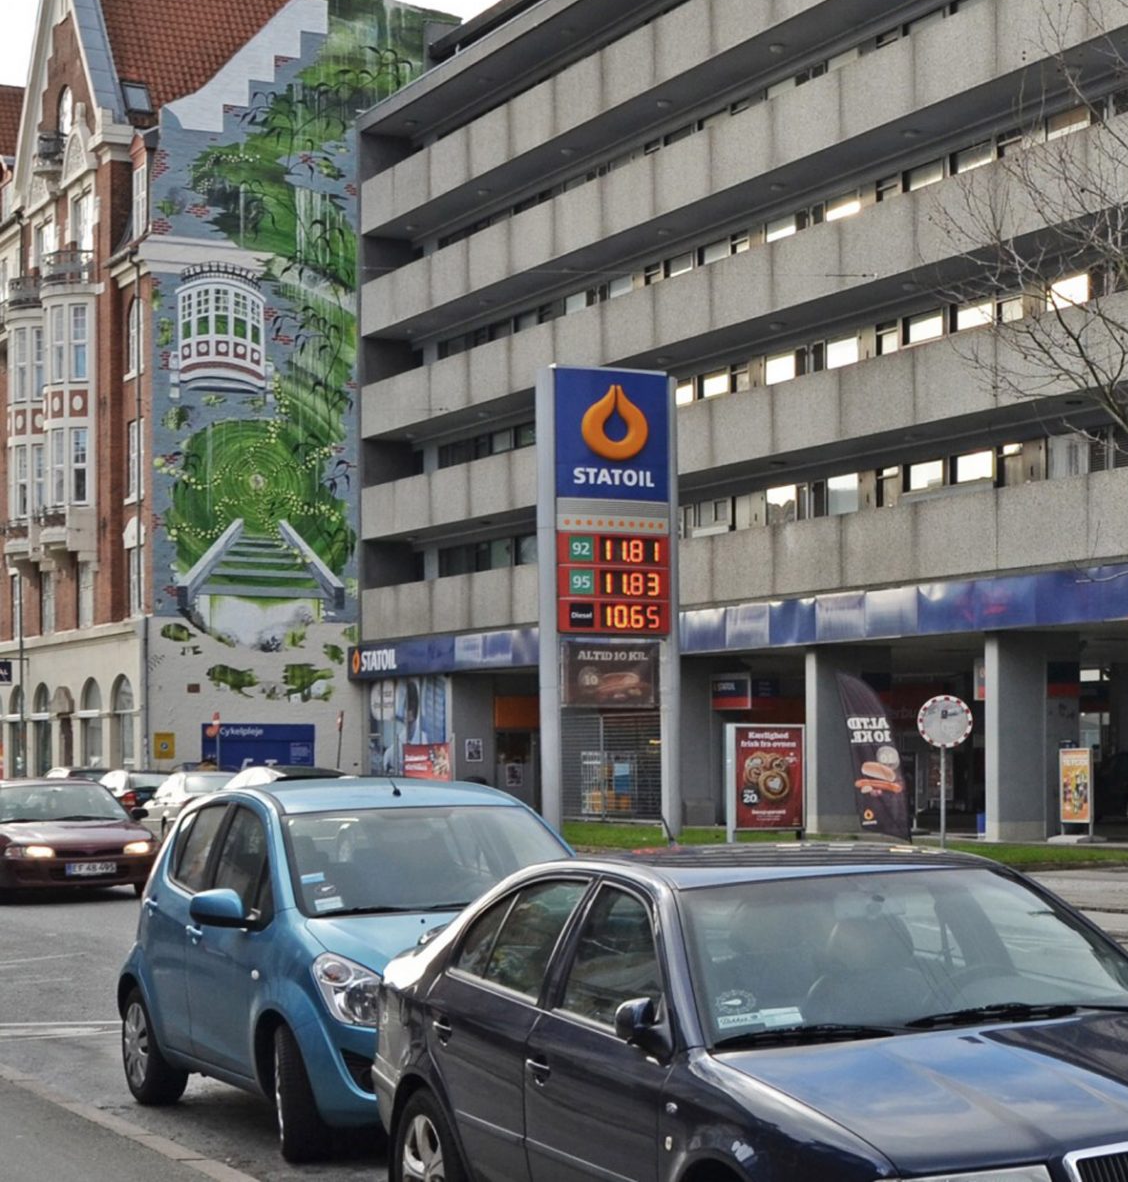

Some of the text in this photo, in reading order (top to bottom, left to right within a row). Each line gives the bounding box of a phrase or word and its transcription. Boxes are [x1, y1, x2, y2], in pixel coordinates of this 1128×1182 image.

[573, 467, 655, 487] STATOIL
[572, 539, 660, 562] 92 11.81
[573, 572, 660, 596] 95 11.83
[571, 605, 660, 629] Diesel 10.65
[361, 648, 397, 672] STATOIL
[578, 650, 613, 661] ALTID
[614, 651, 628, 661] 10
[220, 727, 264, 737] Cykelpleje
